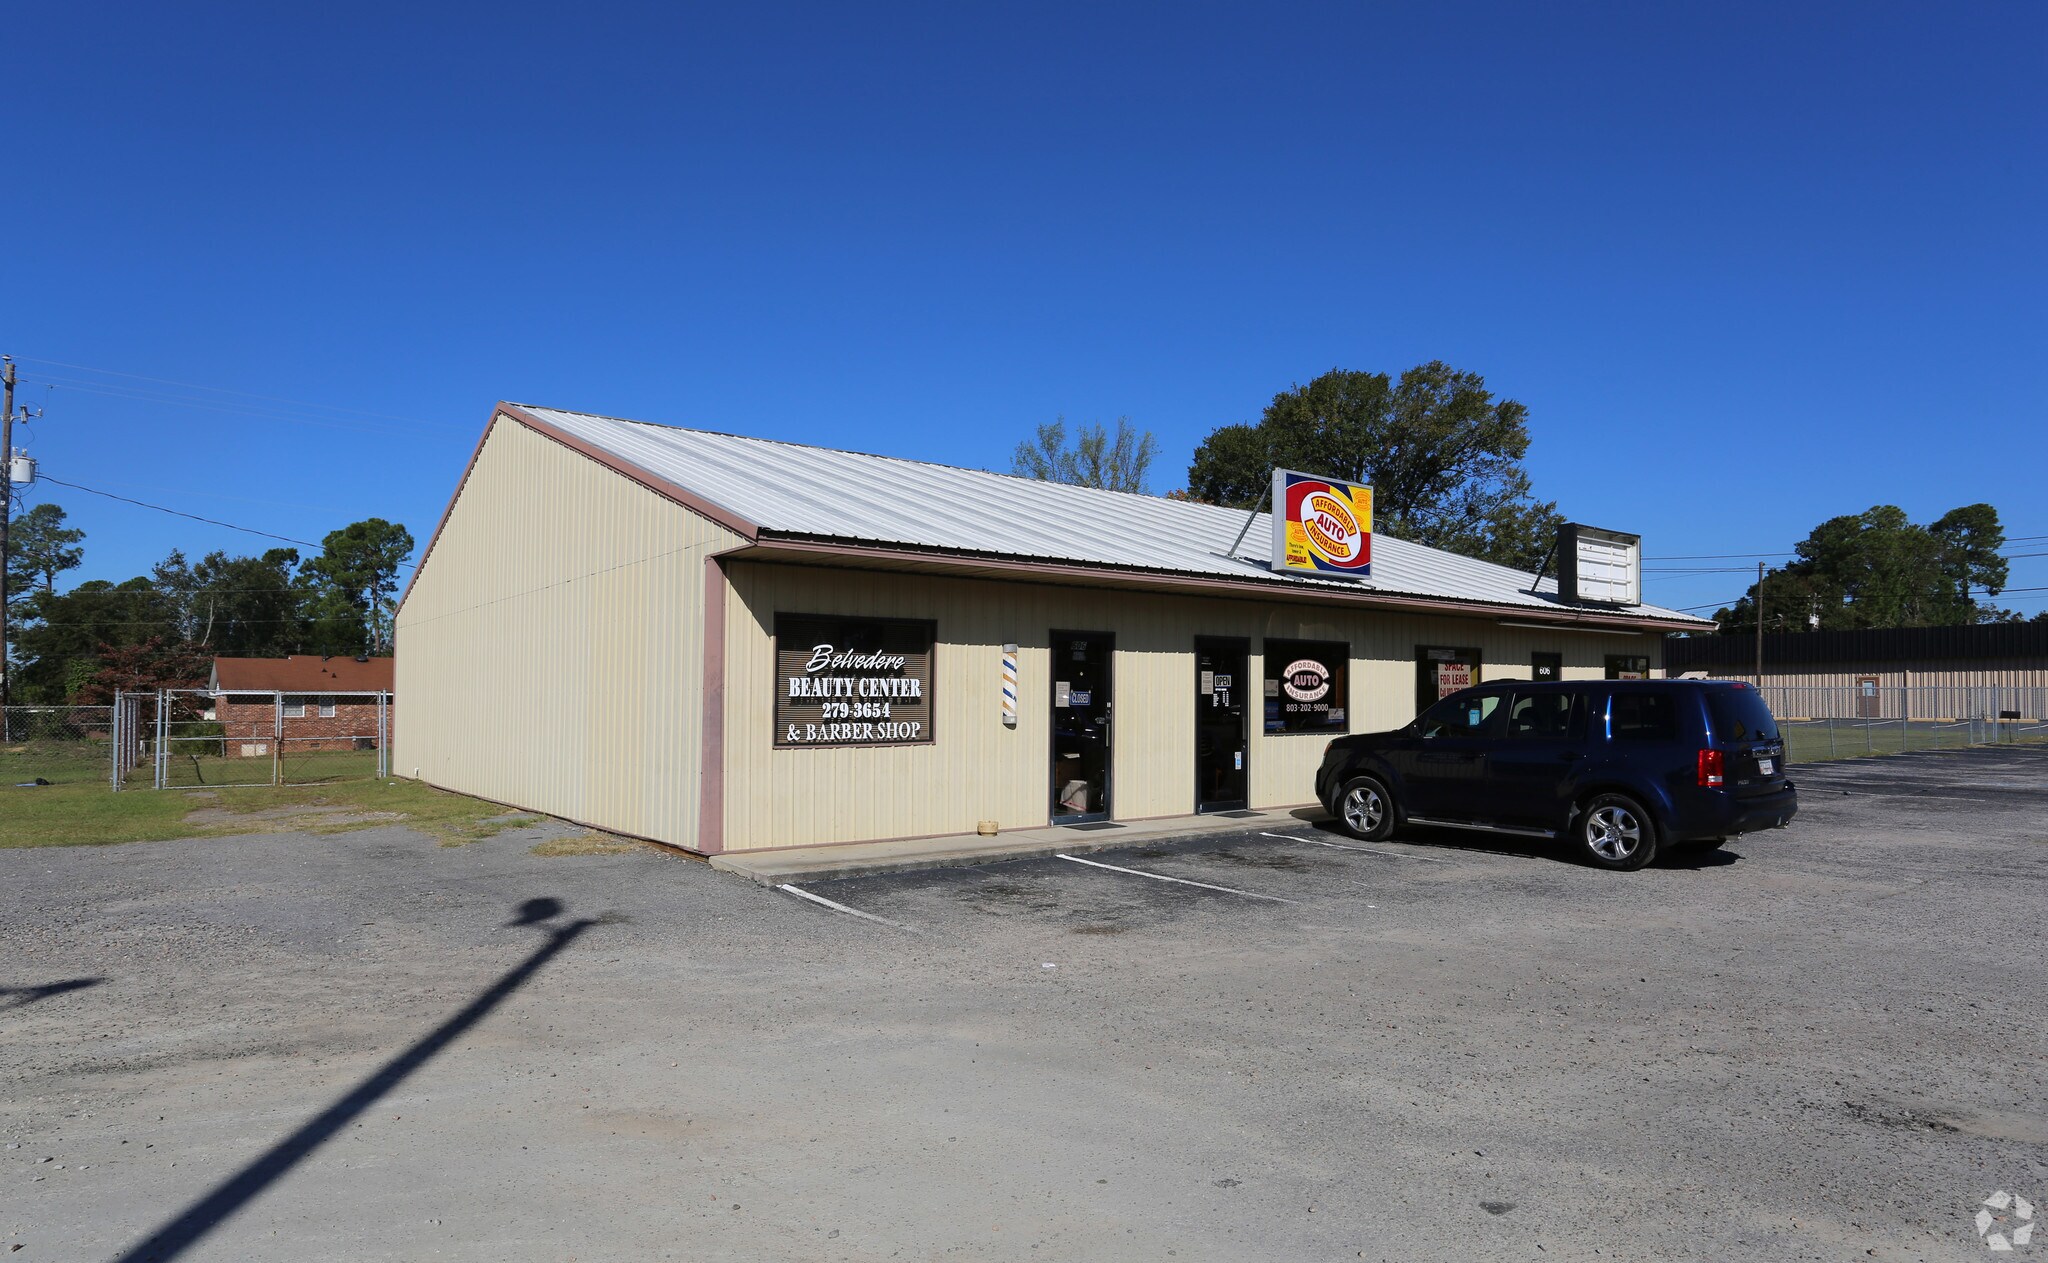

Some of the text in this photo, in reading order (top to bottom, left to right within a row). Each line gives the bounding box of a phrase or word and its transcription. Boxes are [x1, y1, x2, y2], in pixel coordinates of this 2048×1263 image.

[1315, 499, 1354, 533] AFFORDABLE
[1317, 513, 1344, 541] AUTO
[1310, 525, 1345, 556] INSURANCE
[805, 644, 906, 672] Belvedere
[1286, 661, 1327, 678] AFFORDABLE
[788, 677, 922, 697] BEAUTY CENTER
[1215, 676, 1231, 686] OPEN
[1293, 674, 1320, 687] AUTO
[1440, 674, 1469, 686] FOR LEASE
[1071, 693, 1089, 704] CLOSED
[1286, 684, 1327, 699] INSURANCE
[822, 702, 891, 718] 279-3654
[1286, 703, 1329, 712] 803-202-9000
[786, 721, 921, 741] & BARBER SHOP
